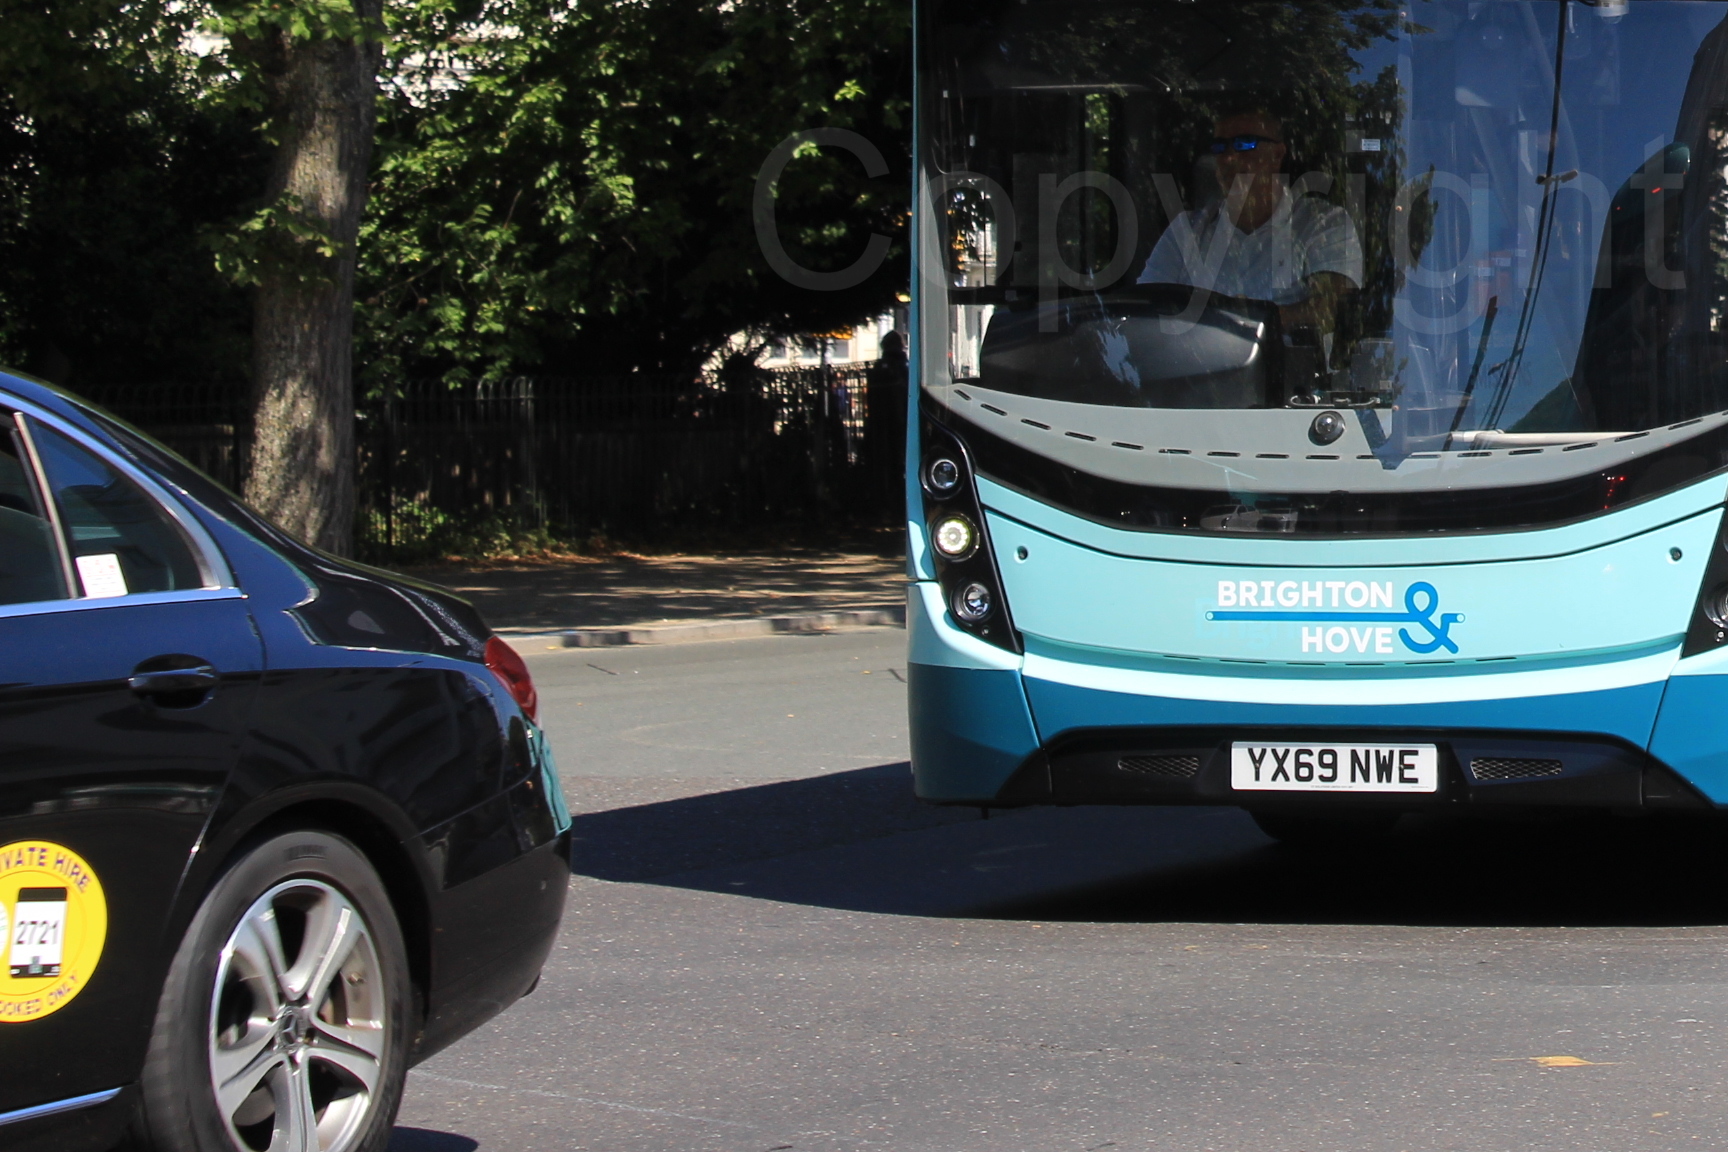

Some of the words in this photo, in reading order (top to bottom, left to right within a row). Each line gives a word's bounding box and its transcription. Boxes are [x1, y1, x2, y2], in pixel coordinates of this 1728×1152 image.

[1217, 580, 1393, 608] BRIGHTON
[1301, 626, 1393, 654] HOVE
[1247, 747, 1338, 783] YX69
[1350, 748, 1419, 784] NWE
[15, 920, 60, 945] 2721
